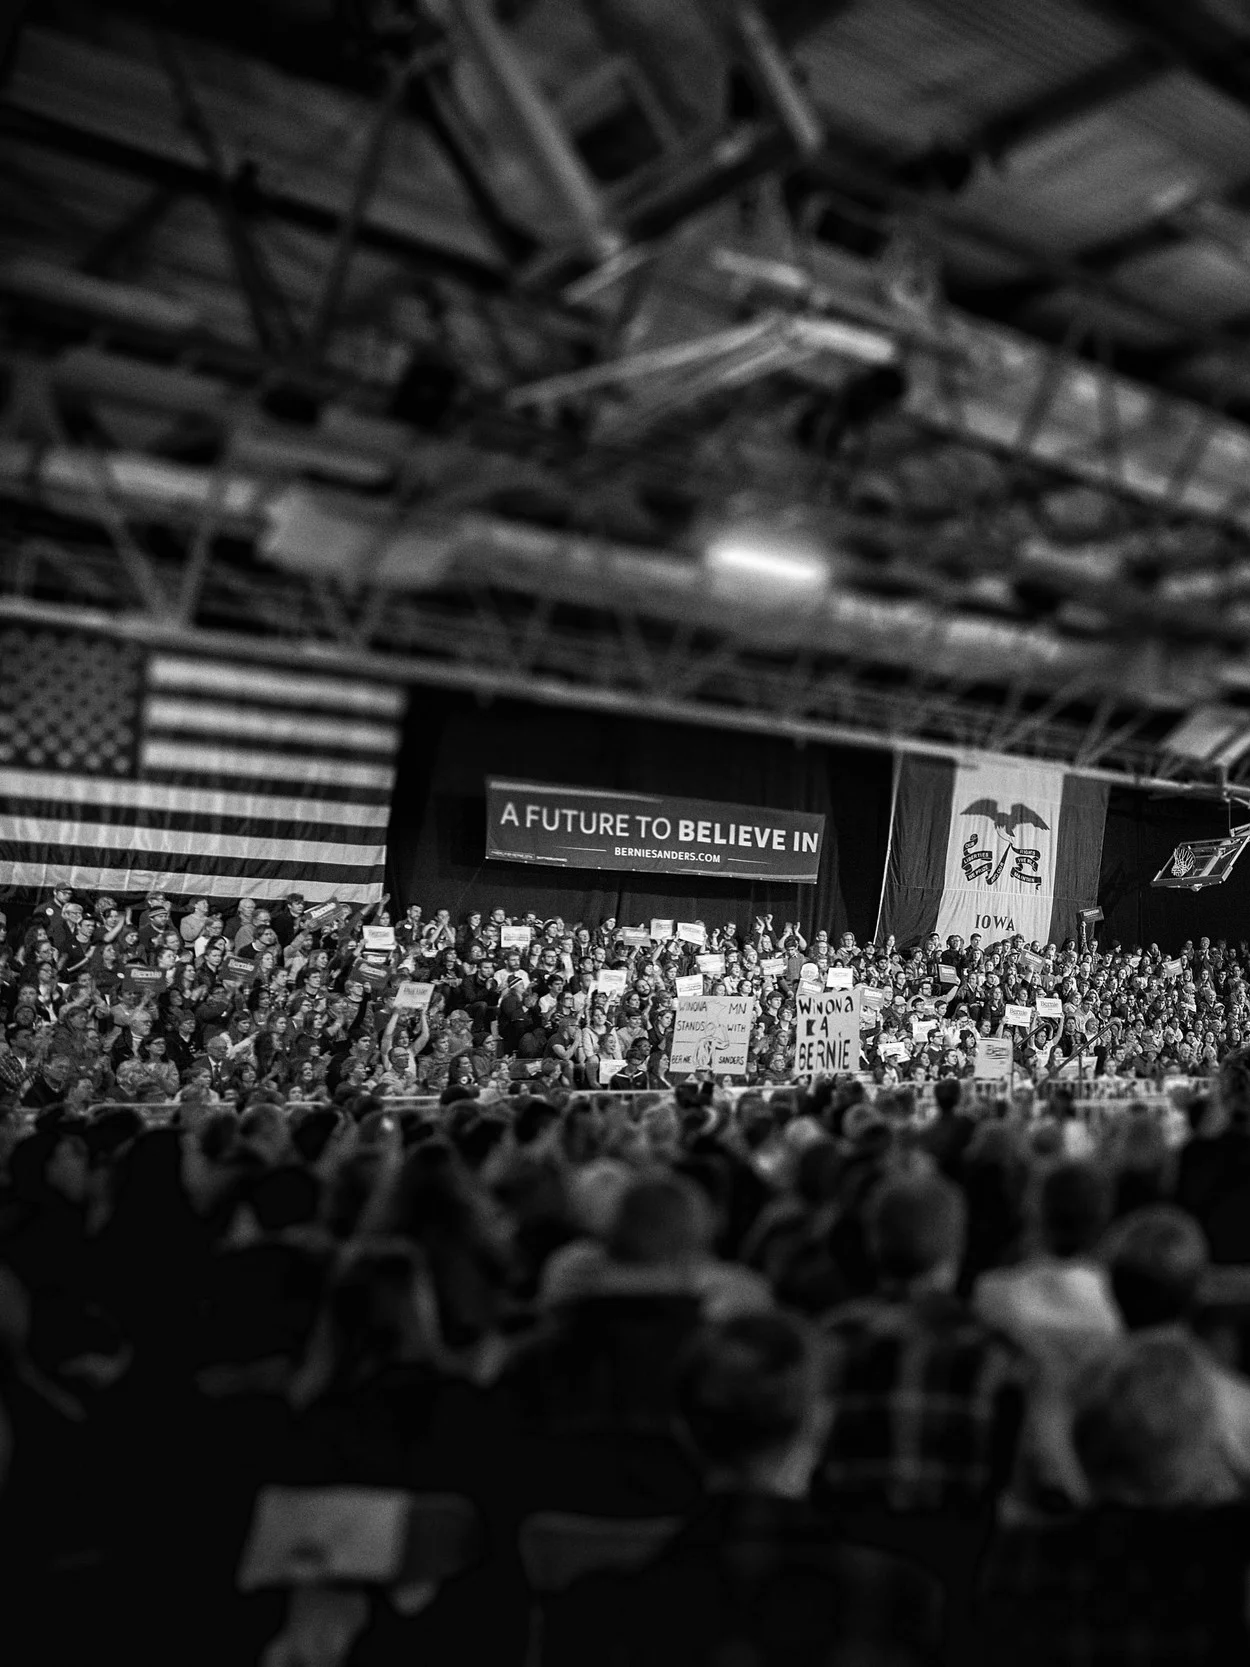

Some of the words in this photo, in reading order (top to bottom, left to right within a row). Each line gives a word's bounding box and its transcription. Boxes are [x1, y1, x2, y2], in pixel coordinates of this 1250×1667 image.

[501, 803, 519, 826] A
[526, 805, 629, 837] FUTURE
[636, 816, 671, 839] TO
[679, 820, 786, 850] BELIEVE
[794, 832, 818, 853] IN
[615, 847, 721, 863] BERNIESANDERS.COM
[975, 914, 1015, 931] IOWA
[729, 1003, 747, 1014] MN
[676, 1021, 705, 1031] STANDS
[727, 1024, 746, 1032] WITH
[718, 1056, 744, 1066] SANDERS
